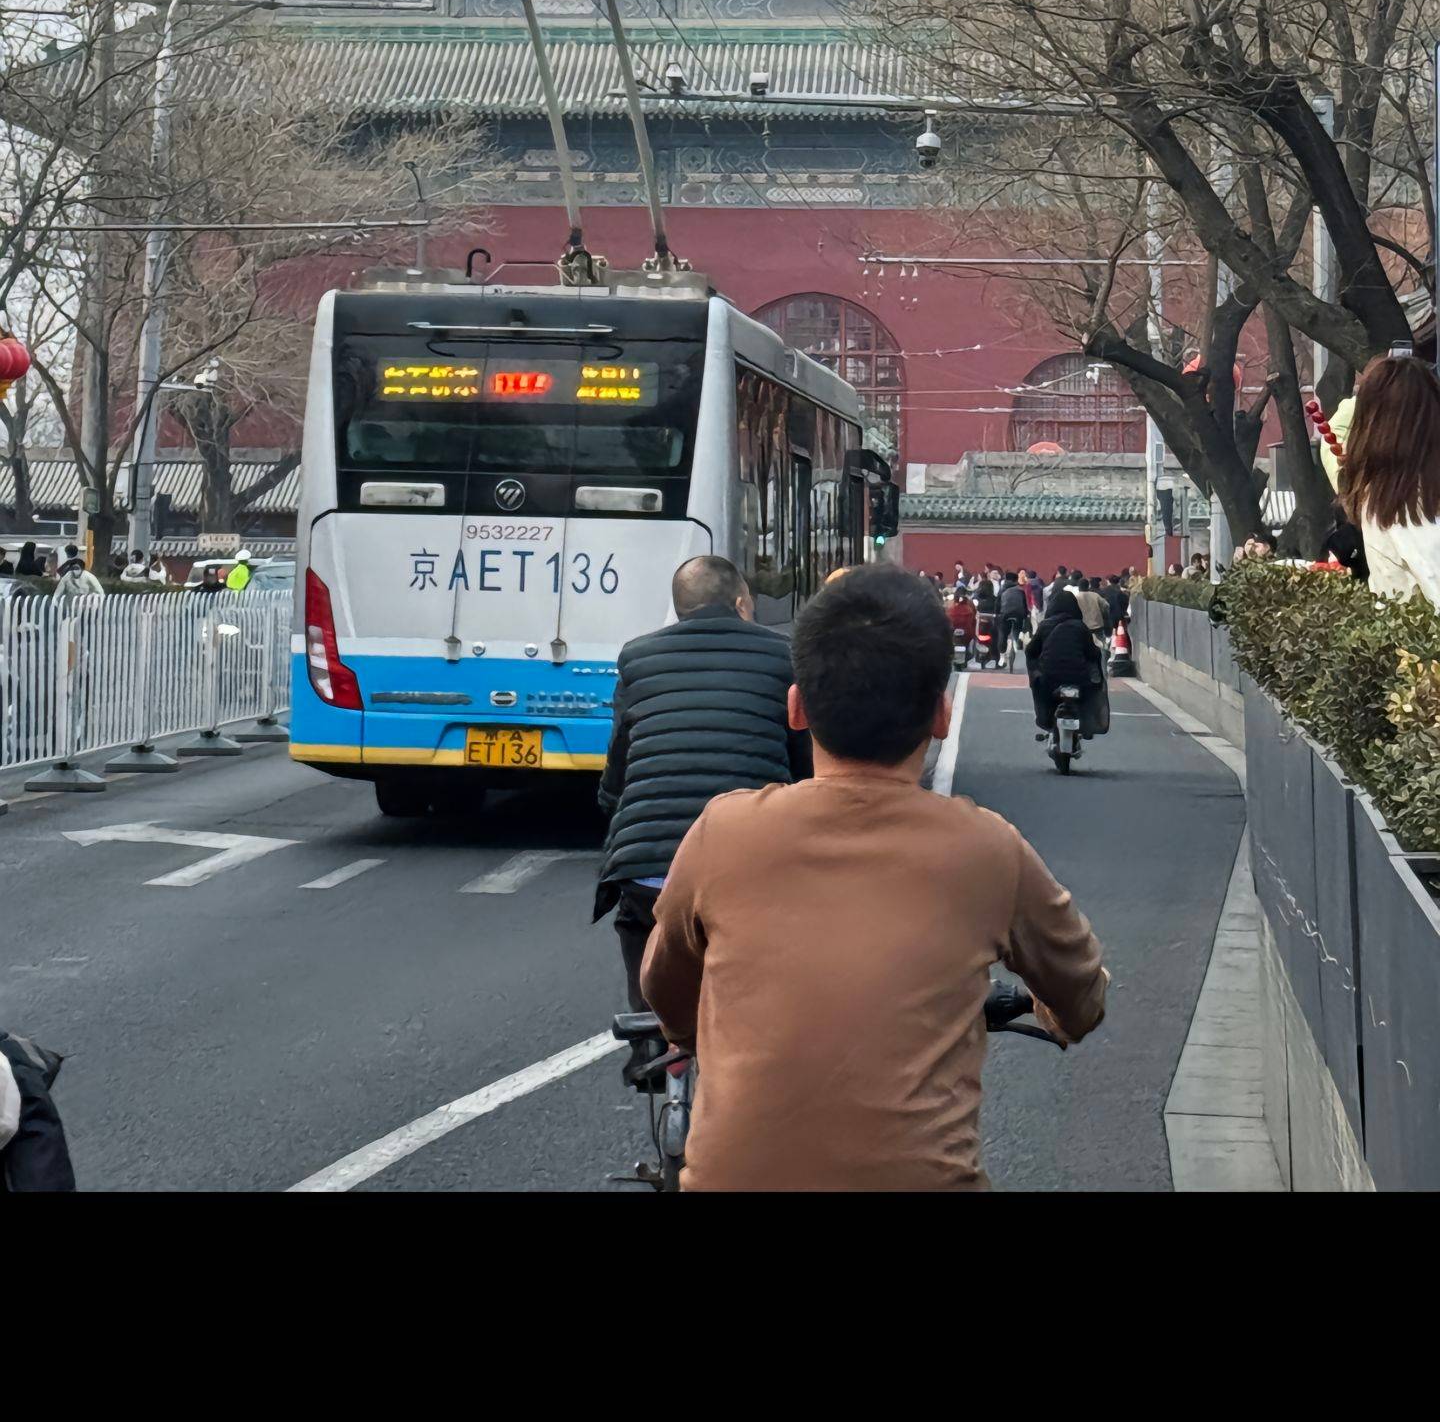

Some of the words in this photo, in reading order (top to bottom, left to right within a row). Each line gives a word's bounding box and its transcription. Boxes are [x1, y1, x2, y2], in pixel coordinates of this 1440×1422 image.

[465, 524, 554, 541] 9532227
[408, 547, 619, 594] 京AET136
[467, 741, 538, 765] ET136
